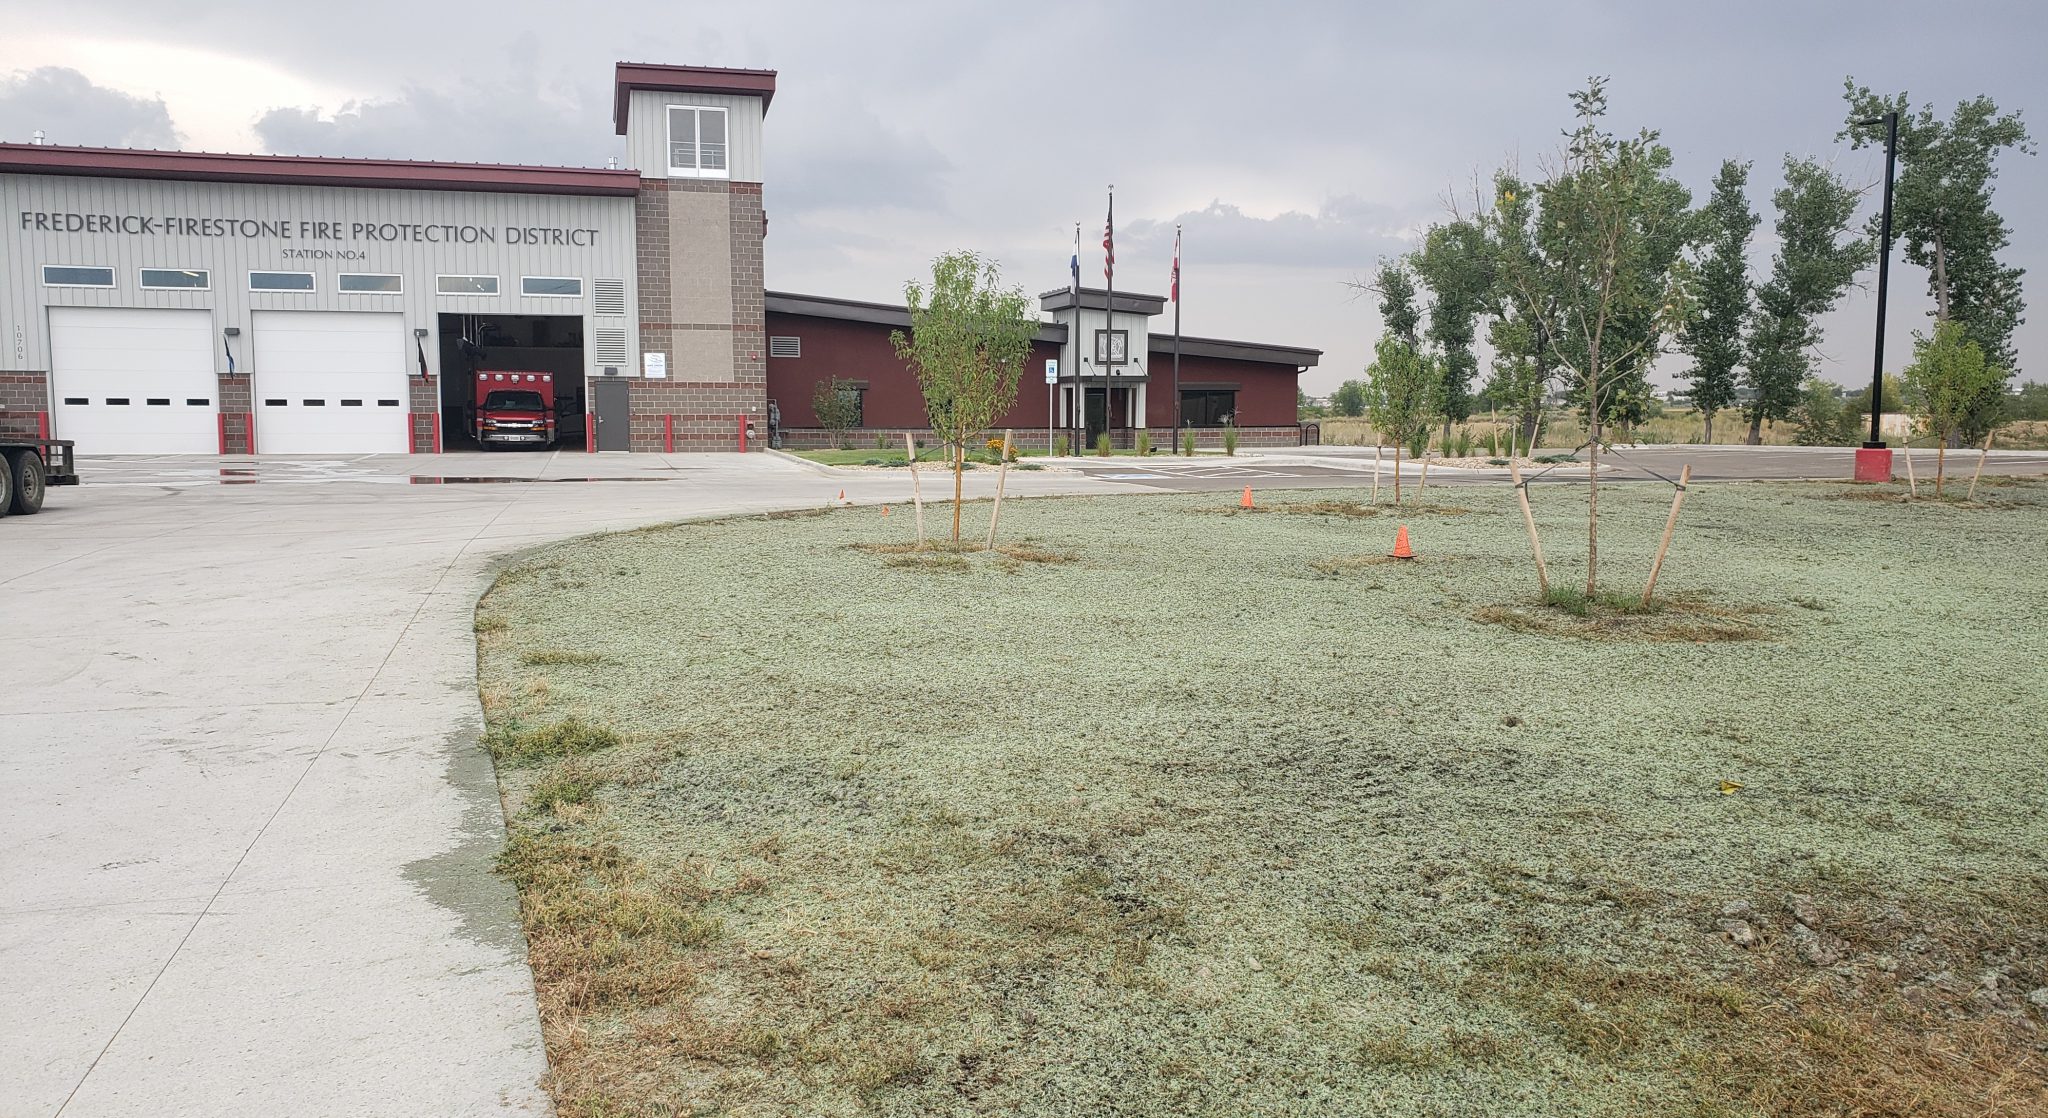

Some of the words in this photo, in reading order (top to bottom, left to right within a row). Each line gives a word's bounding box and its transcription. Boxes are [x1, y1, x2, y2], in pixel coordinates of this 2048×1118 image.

[21, 211, 292, 239] FREDERICK-FIRESTONE
[300, 221, 342, 240] FIRE
[352, 223, 495, 244] PROTECTION
[505, 227, 599, 247] DISTRICT
[282, 248, 333, 260] STATION
[337, 250, 366, 260] NO.4
